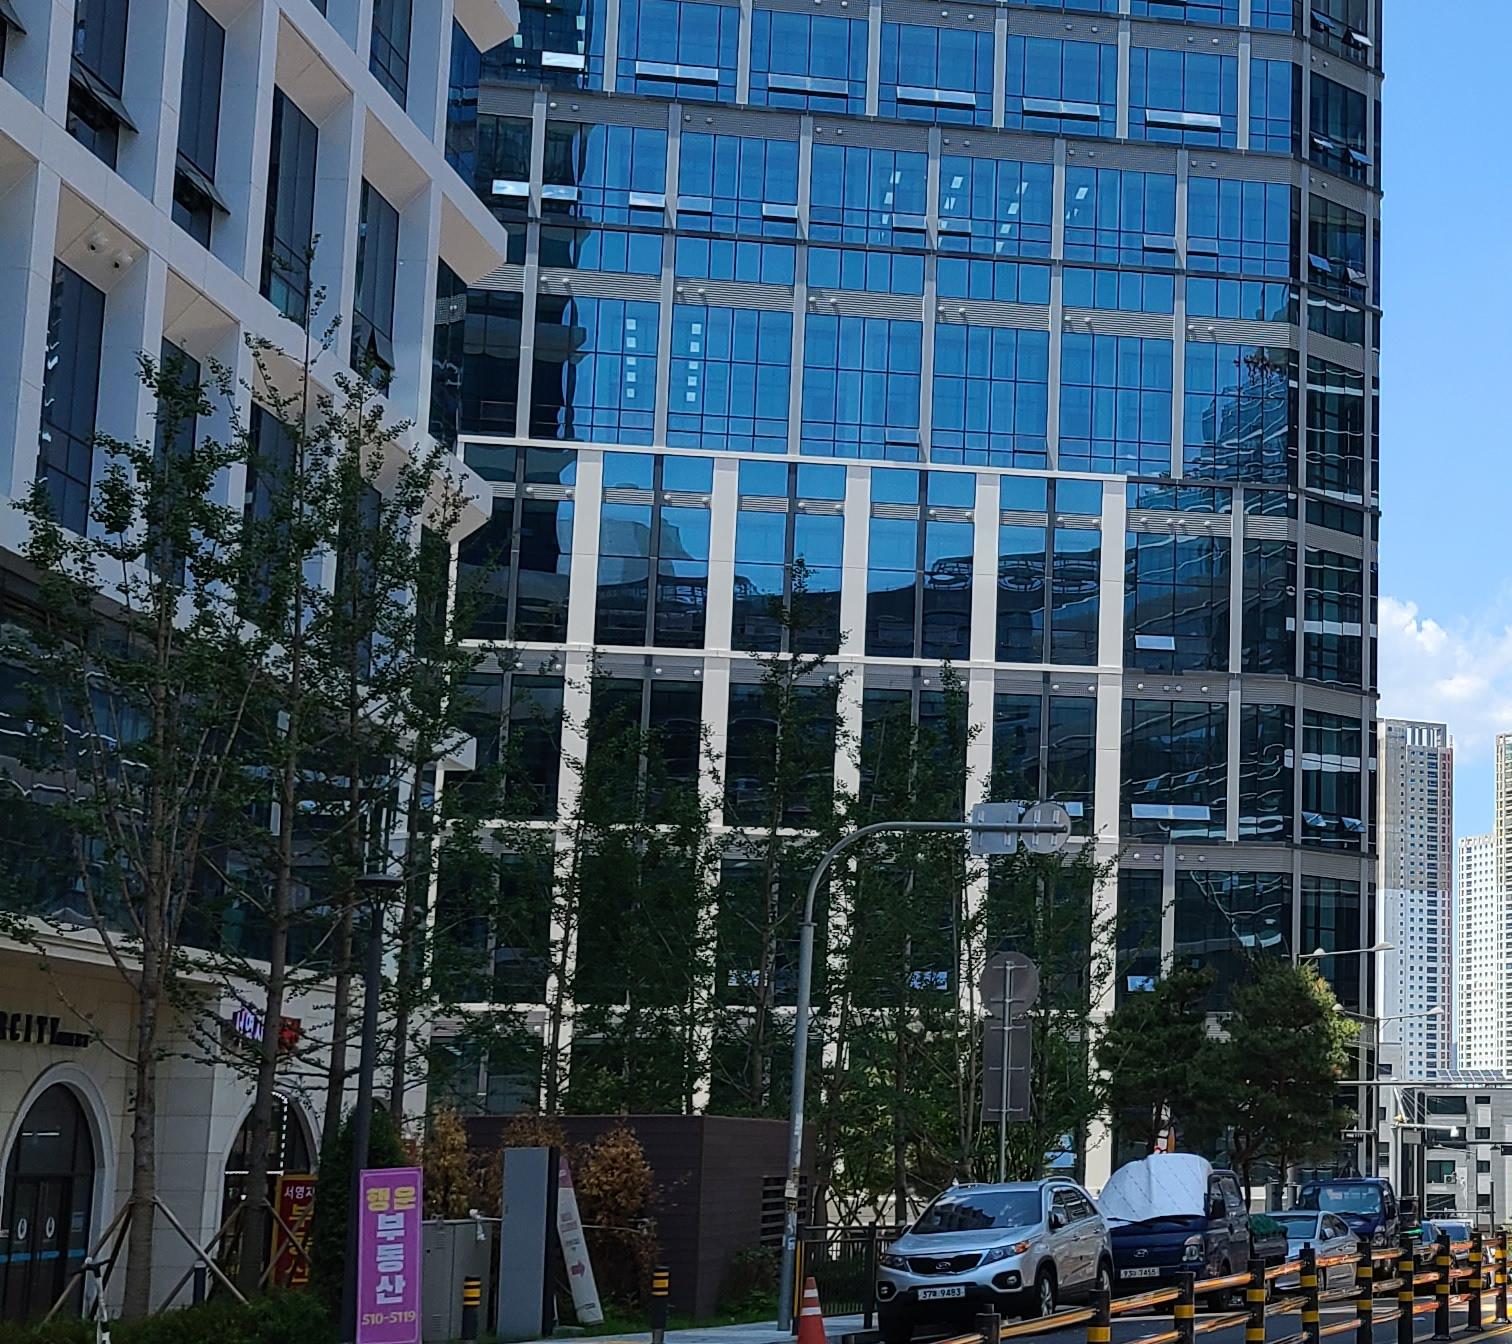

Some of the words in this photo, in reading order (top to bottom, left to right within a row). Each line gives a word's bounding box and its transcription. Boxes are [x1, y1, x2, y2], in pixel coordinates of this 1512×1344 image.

[366, 1186, 417, 1212] 행운
[375, 1212, 406, 1305] 부동산
[361, 1310, 417, 1326] 510-5119
